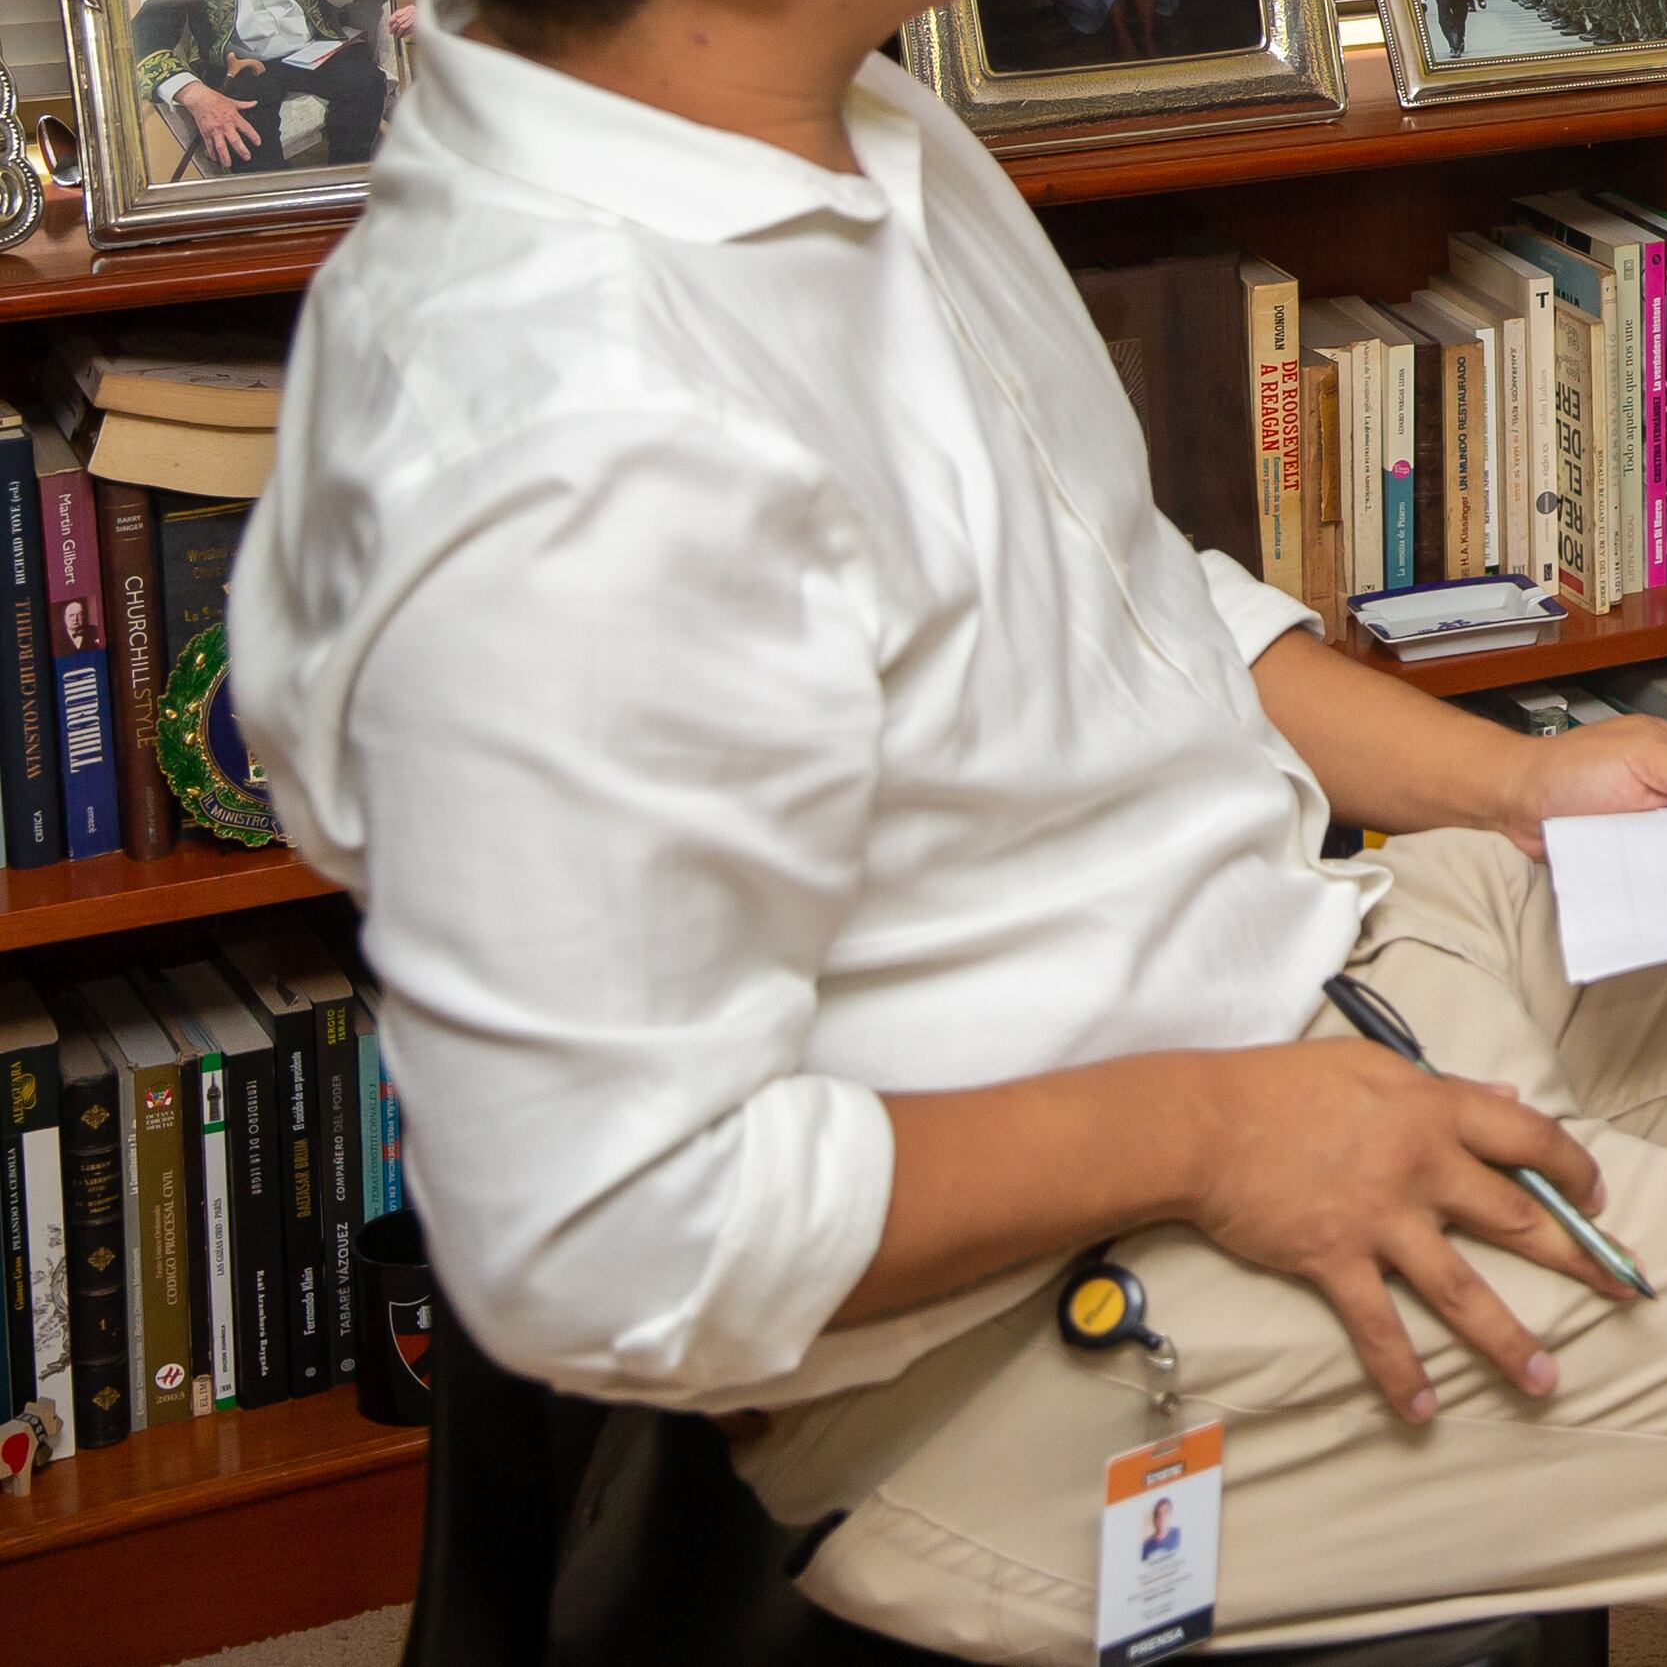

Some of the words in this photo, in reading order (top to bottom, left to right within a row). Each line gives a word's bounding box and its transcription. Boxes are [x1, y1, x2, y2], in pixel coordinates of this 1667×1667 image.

[1273, 304, 1285, 351] DONOVAN
[1625, 319, 1633, 341] une
[1652, 297, 1661, 333] historia
[1260, 364, 1278, 377] A
[1282, 359, 1298, 383] DE
[1652, 334, 1661, 380] verdadera
[1457, 355, 1468, 431] RESTAURADO
[1626, 371, 1638, 393] que
[1653, 381, 1661, 391] La
[1260, 382, 1280, 452] REAGAN
[1624, 396, 1637, 443] aquello
[1282, 387, 1300, 491] ROOSEVELT
[1457, 434, 1468, 475] MUNDO
[1564, 459, 1583, 497] EL
[1599, 449, 1607, 485] RONALD
[1623, 444, 1635, 477] Todo
[8, 480, 22, 503] (ed.)
[1458, 476, 1468, 491] UN
[10, 505, 23, 535] TOYE
[58, 492, 73, 536] Martin
[116, 514, 142, 525] BARRY
[1458, 496, 1471, 543] Kissinger
[1599, 487, 1607, 524] REAGAN
[1654, 499, 1662, 527] Marco
[115, 522, 144, 533] SINGER
[1600, 526, 1607, 537] EL
[13, 535, 27, 585] RICHARD
[62, 538, 78, 586] Gilbert
[1654, 540, 1663, 564] Laura
[15, 596, 37, 697] CHURCHILL
[62, 666, 104, 774] CHURCHILL
[22, 700, 43, 781] WINSTON
[33, 809, 45, 843] CRÍTICA
[86, 806, 97, 834] emecé
[209, 803, 270, 829] MINISTRO
[328, 1008, 336, 1045] SERGIO
[338, 1006, 346, 1041] ISRAEL
[10, 1060, 24, 1125] ALFAGUARA
[332, 1074, 345, 1111] PODER
[333, 1113, 345, 1133] DEL
[369, 1093, 379, 1173] CONSTITUCIONALES
[249, 1137, 260, 1151] DE
[8, 1147, 18, 1190] CEBOLLA
[162, 1169, 174, 1198] CIVIL
[332, 1135, 346, 1202] COMPAÑERO
[10, 1190, 19, 1204] LA
[295, 1171, 312, 1219] BALTASAR
[370, 1174, 380, 1204] TEMAS
[10, 1206, 22, 1251] PELANDO
[164, 1200, 176, 1255] PROCESAL
[216, 1263, 225, 1276] LAS
[335, 1221, 351, 1284] VÁZQUEZ
[165, 1256, 177, 1306] CODIGO
[301, 1266, 313, 1290] Klein
[301, 1291, 315, 1336] Fernando
[336, 1286, 351, 1336] TABARÉ
[1127, 1627, 1186, 1661] PRENSA
